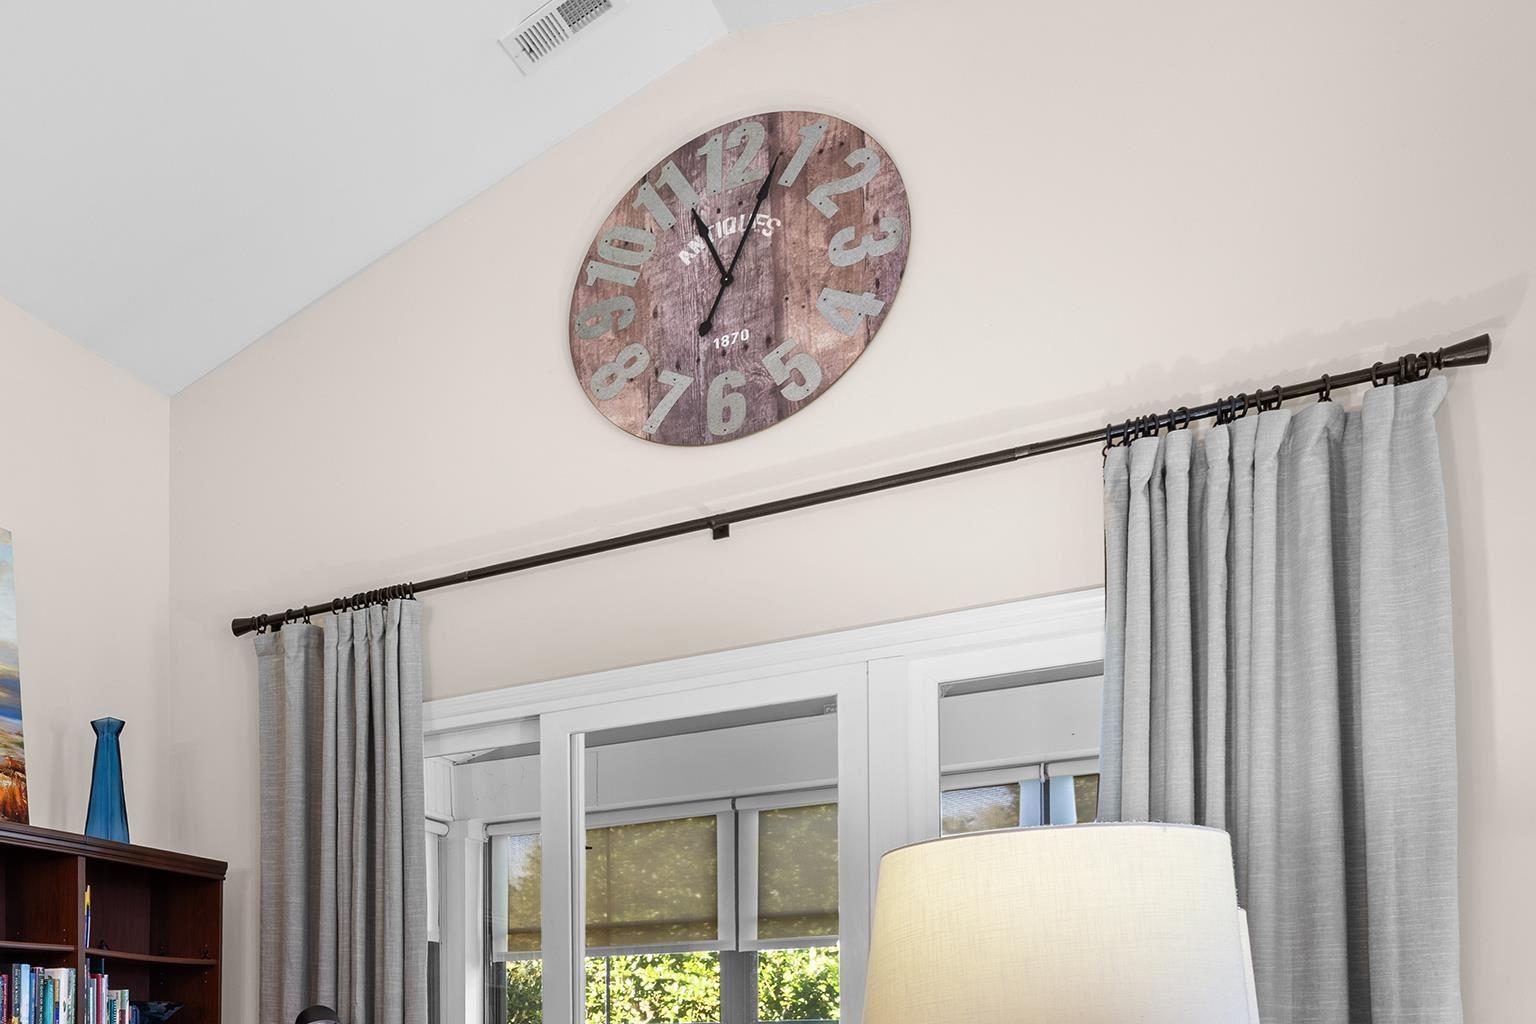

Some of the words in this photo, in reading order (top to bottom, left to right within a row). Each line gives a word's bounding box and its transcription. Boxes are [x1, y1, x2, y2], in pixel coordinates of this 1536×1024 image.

[697, 121, 765, 196] 12
[778, 120, 829, 187] 1
[806, 147, 881, 219] 2
[632, 160, 700, 231] 11
[586, 226, 656, 287] 10
[828, 217, 903, 267] 3
[575, 295, 636, 339] 9
[713, 329, 750, 349] 1870
[815, 287, 885, 337] 4
[590, 342, 651, 401] 8
[641, 369, 694, 435] 7
[762, 338, 823, 402] 5
[706, 370, 747, 435] 6
